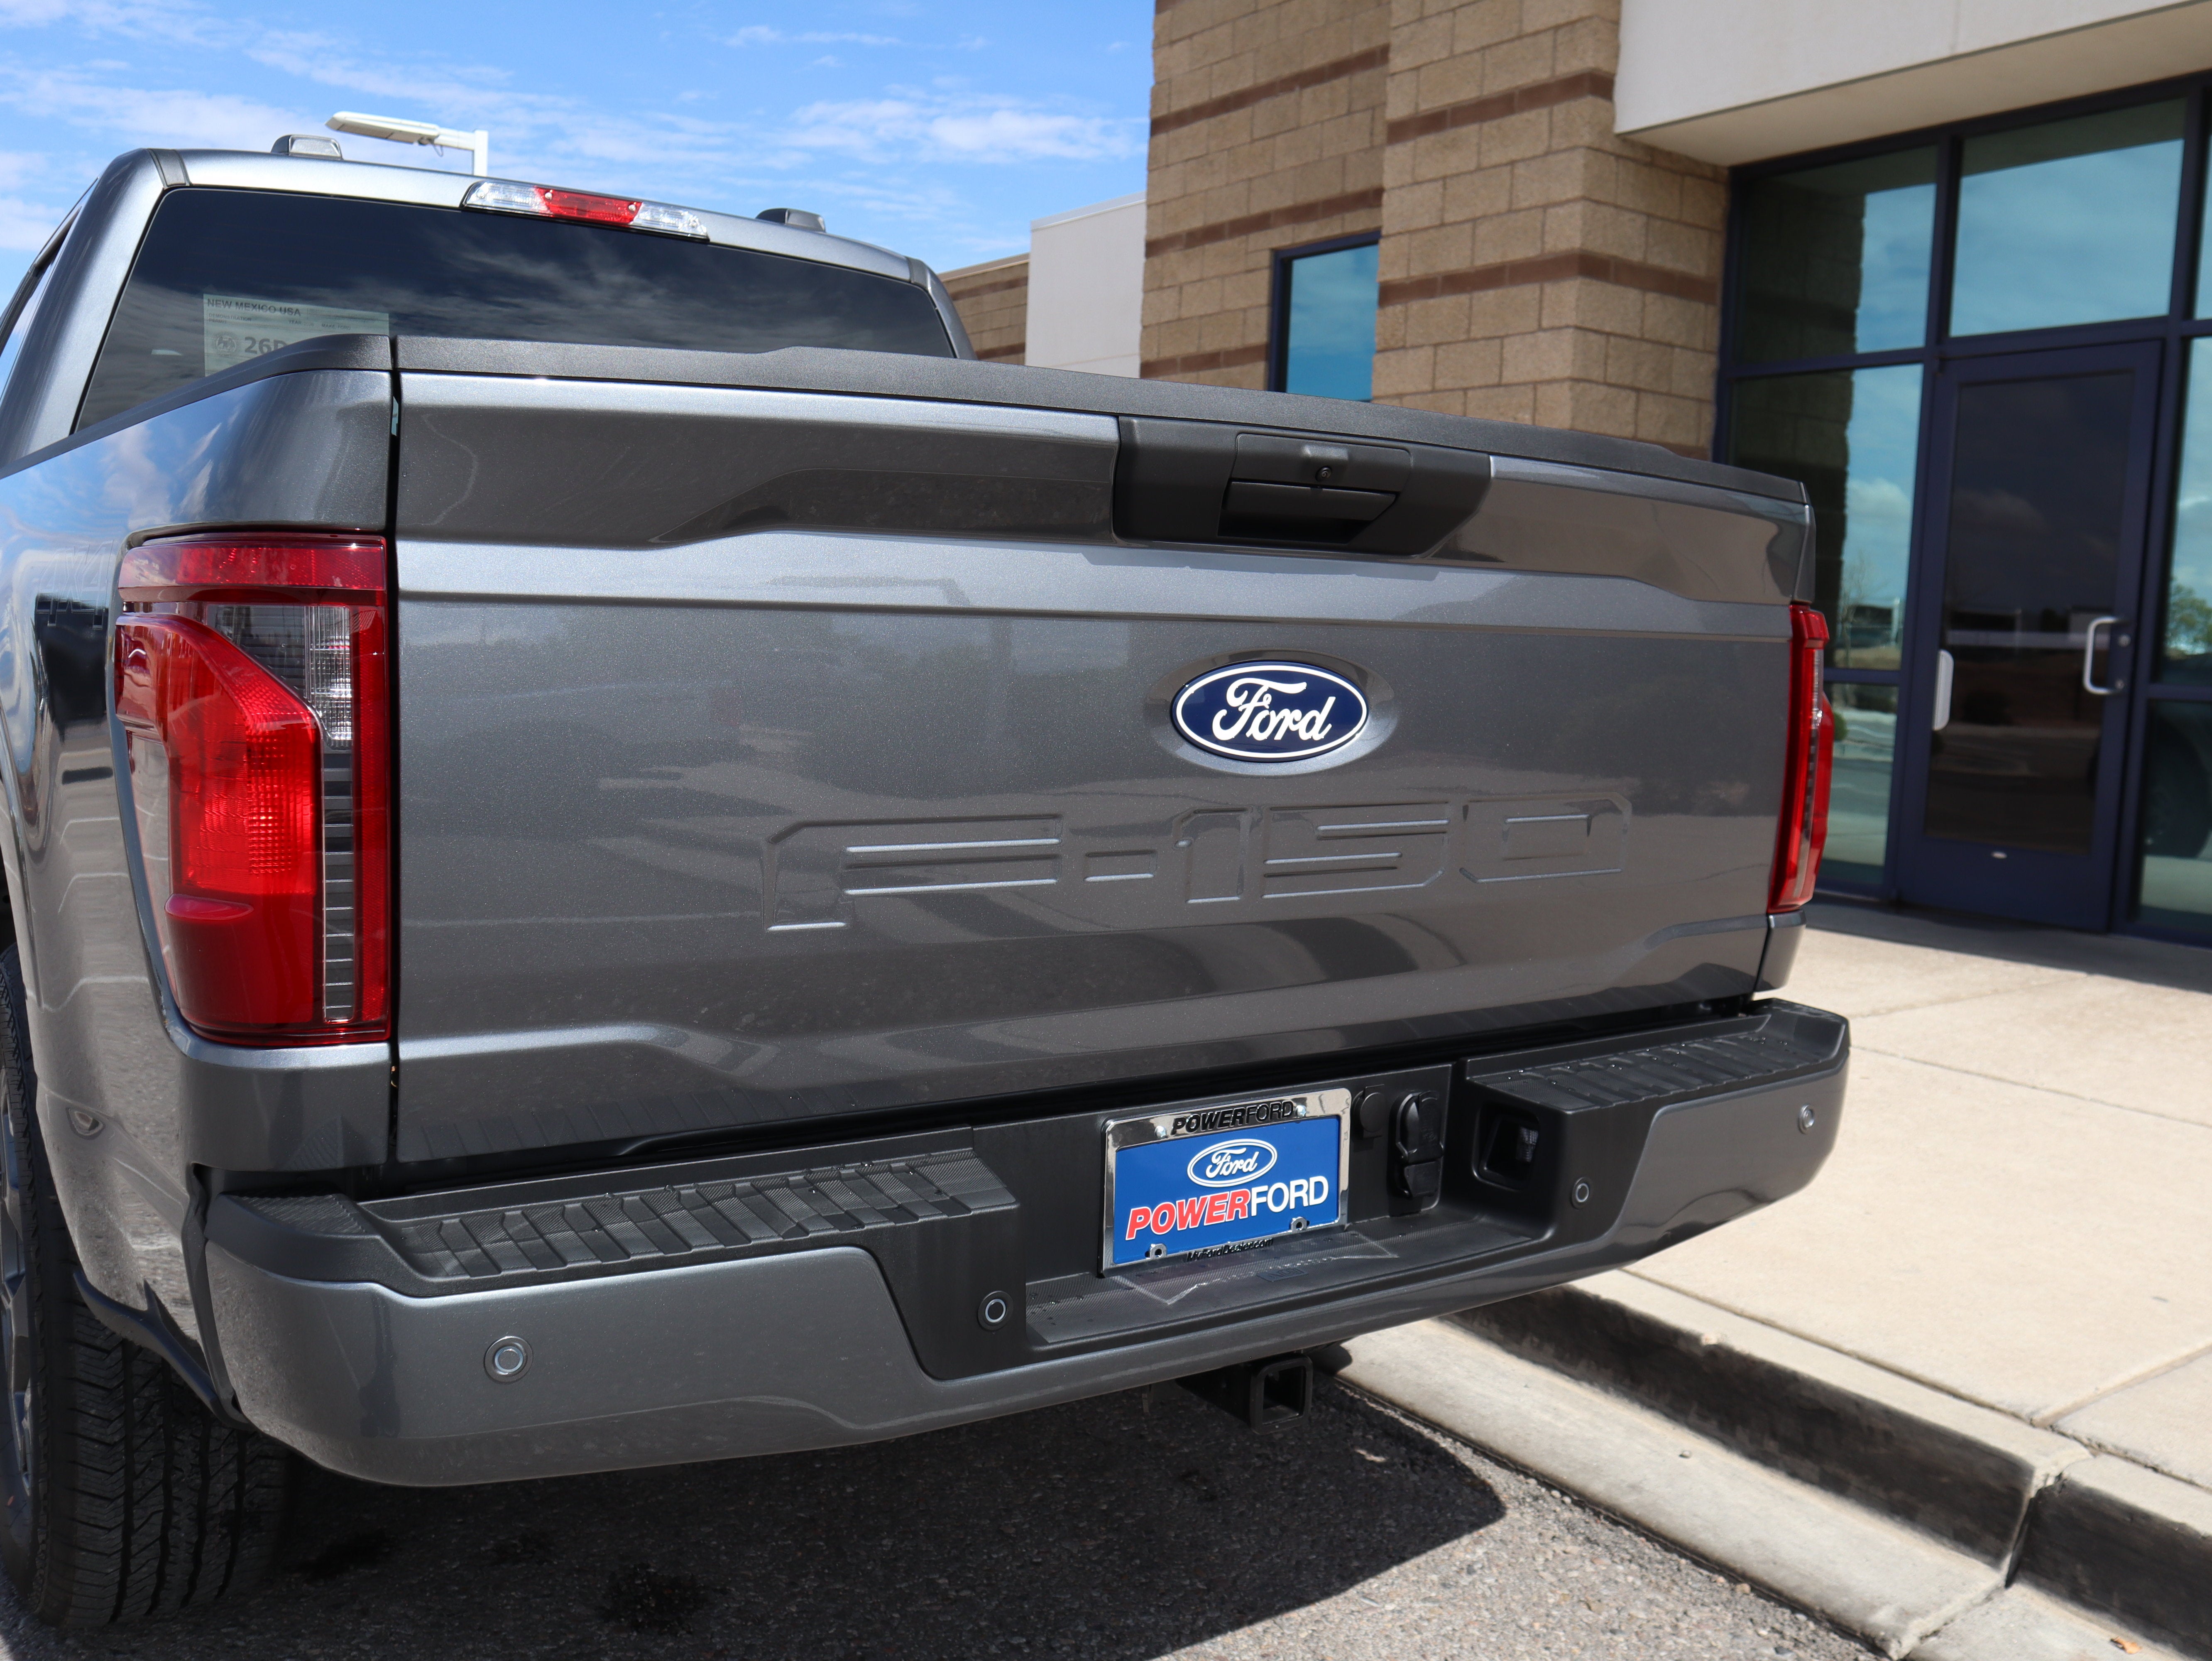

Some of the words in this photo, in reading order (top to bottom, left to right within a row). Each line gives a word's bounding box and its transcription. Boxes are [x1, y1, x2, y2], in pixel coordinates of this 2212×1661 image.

[208, 298, 232, 309] NEW
[235, 301, 276, 314] MEXICO
[279, 306, 301, 316] USA
[208, 313, 252, 321] DEMONSTRATION
[1212, 677, 1336, 741] Ford
[763, 792, 1632, 931] F-150
[1170, 1100, 1295, 1135] POWERFORD
[1205, 1147, 1260, 1178] Ford
[1125, 1175, 1329, 1241] POWERFORD
